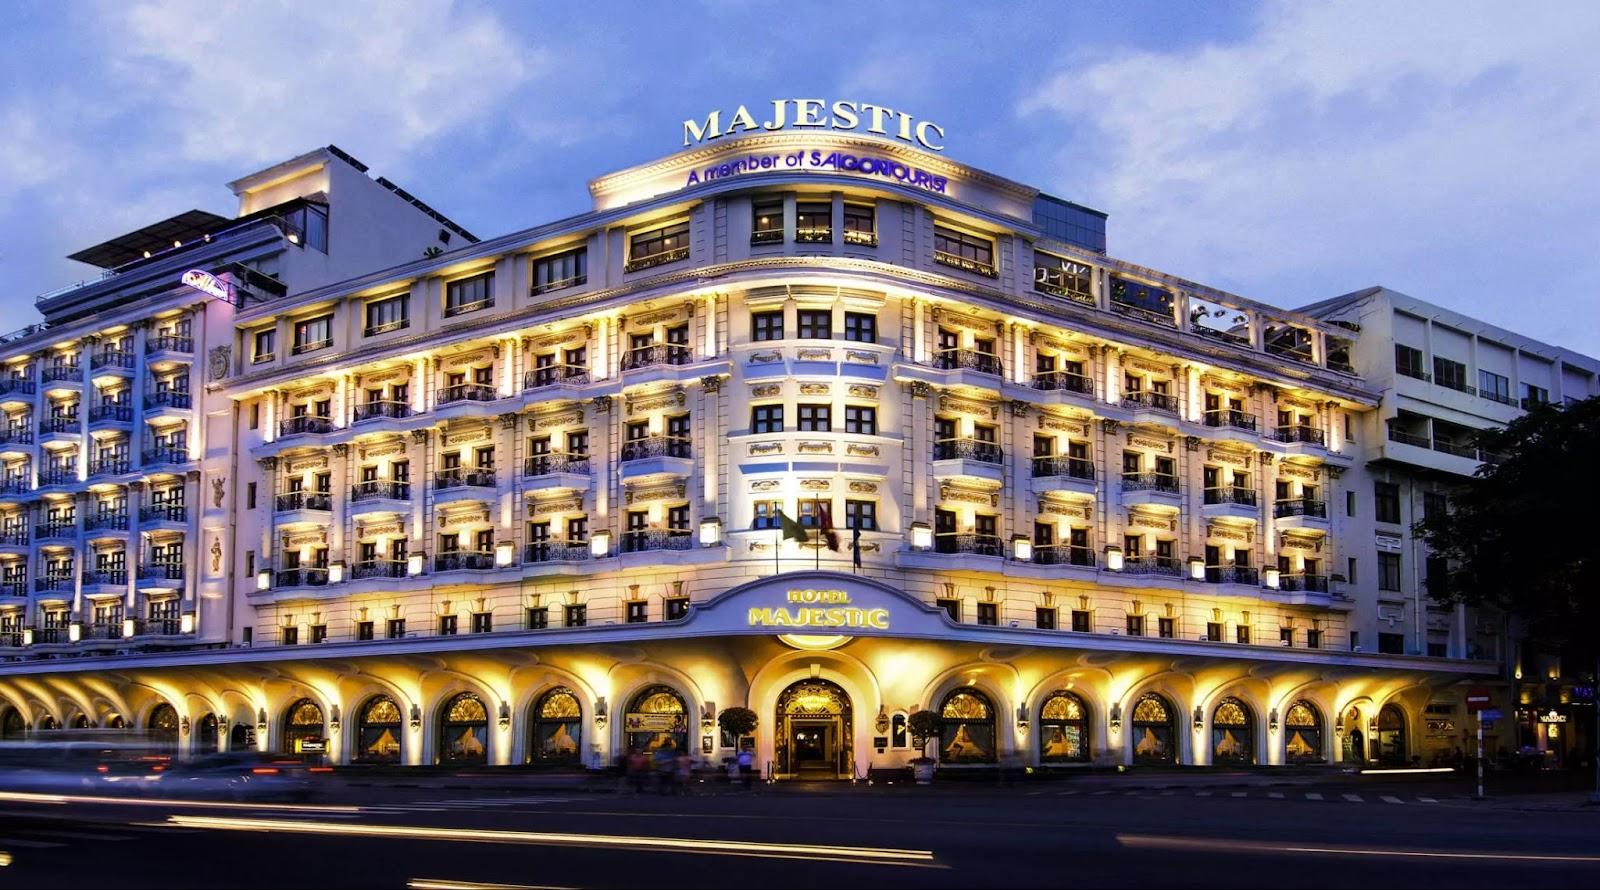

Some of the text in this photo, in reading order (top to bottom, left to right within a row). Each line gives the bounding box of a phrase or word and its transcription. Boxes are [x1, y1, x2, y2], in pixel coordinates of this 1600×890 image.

[683, 98, 945, 150] MAJESTIC
[686, 149, 948, 193] A member of SAIGONTOURIST
[787, 589, 851, 604] HOTEL
[748, 607, 890, 629] MAJESTIC
